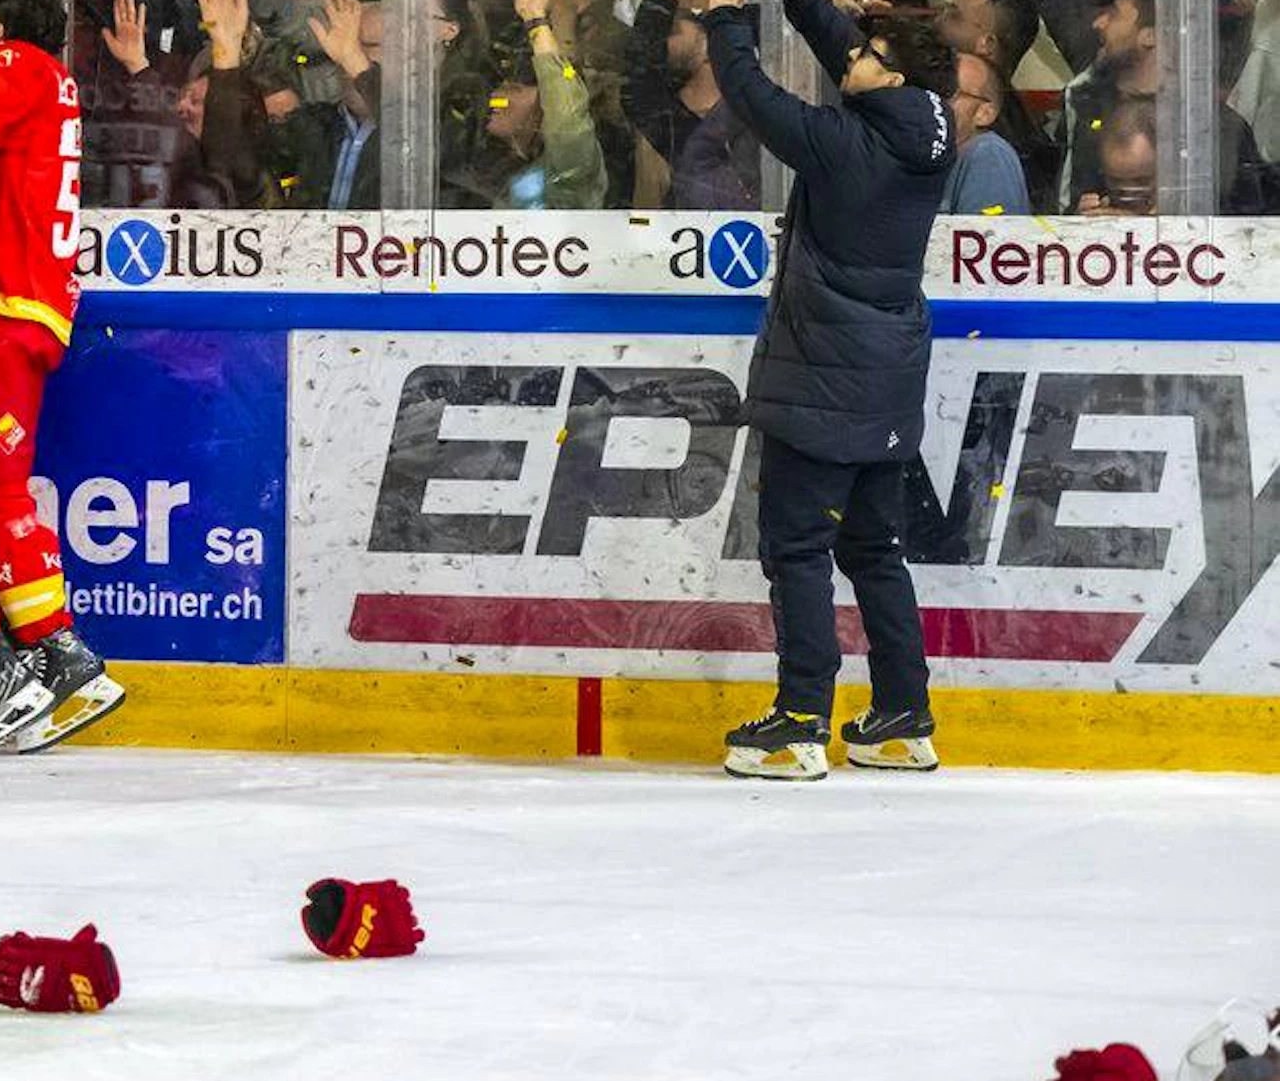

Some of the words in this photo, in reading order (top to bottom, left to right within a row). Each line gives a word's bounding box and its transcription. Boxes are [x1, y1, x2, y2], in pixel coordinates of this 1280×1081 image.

[74, 213, 264, 286] axius
[334, 224, 590, 278] Renotec
[952, 229, 1227, 287] Renotec
[204, 526, 264, 565] sa
